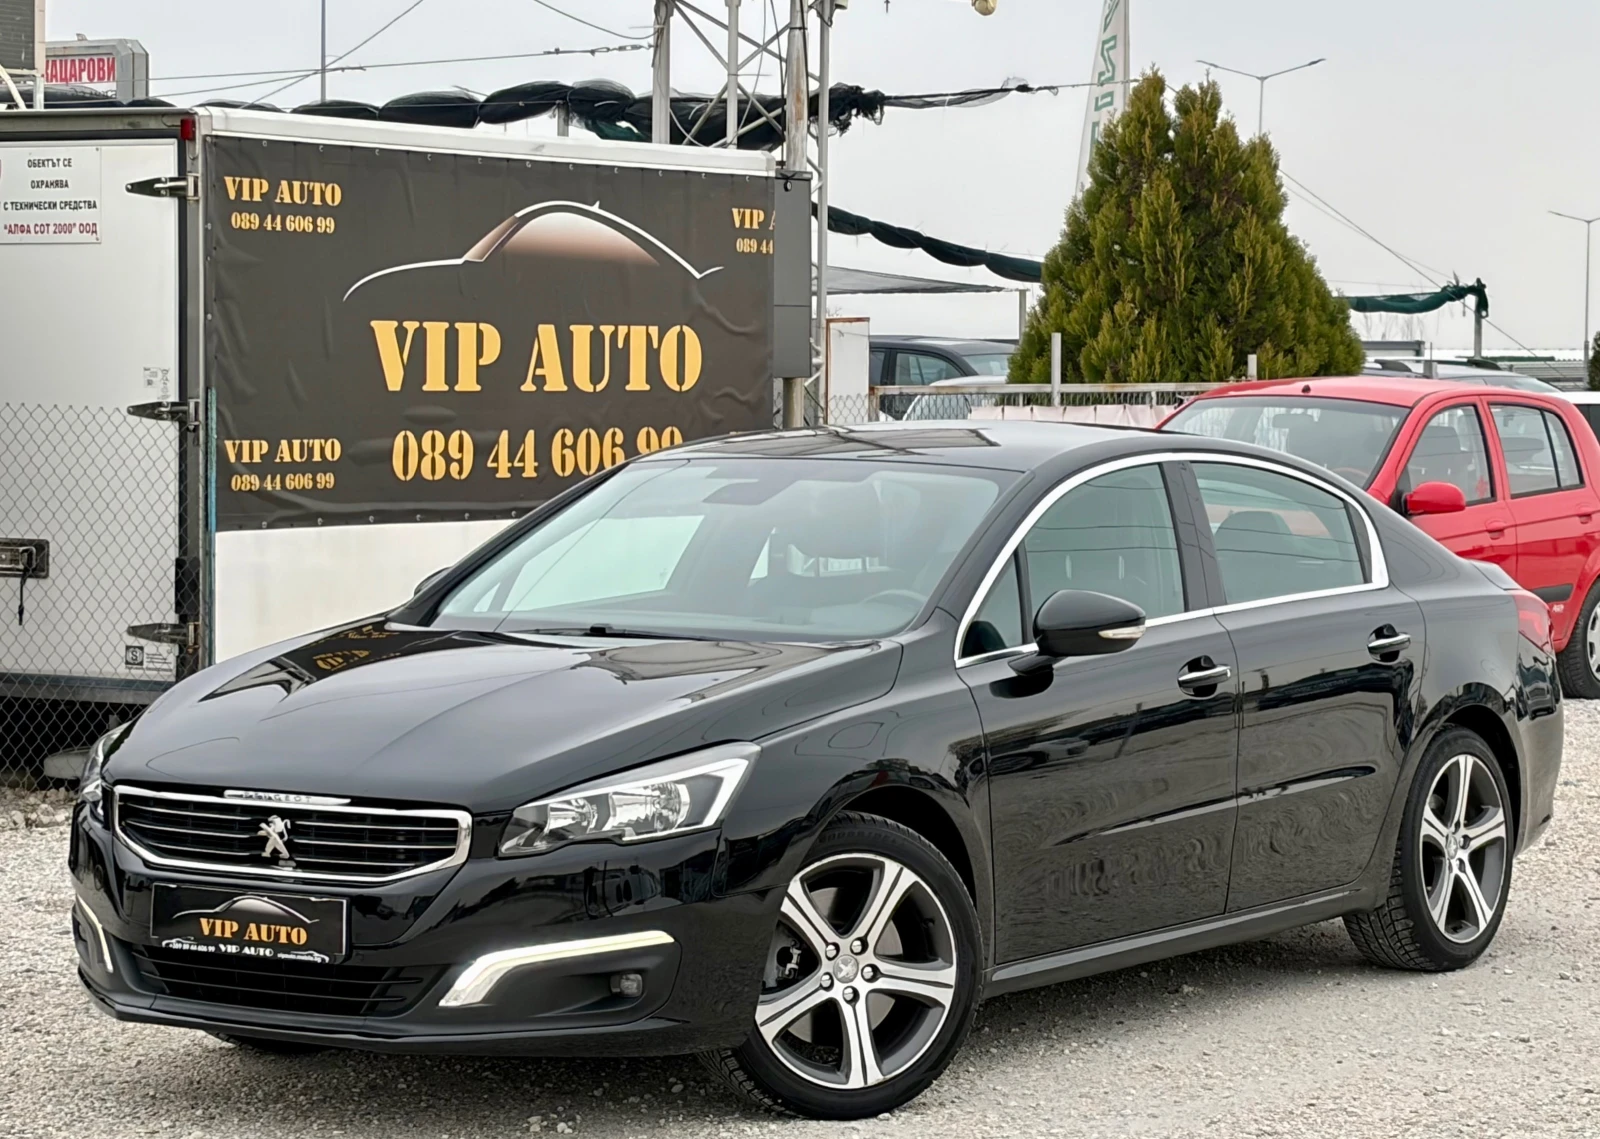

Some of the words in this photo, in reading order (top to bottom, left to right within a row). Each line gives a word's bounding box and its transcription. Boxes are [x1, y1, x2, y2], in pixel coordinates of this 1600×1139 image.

[27, 158, 61, 168] ОБЕКТЪТ
[62, 158, 72, 168] СЕ
[30, 179, 69, 189] ОХРАНЯВА
[224, 176, 269, 202] VIP
[274, 180, 342, 206] AUTO
[10, 201, 57, 211] ТЕХНИЧЕСКИ
[59, 200, 97, 211] СРЕДСТВА
[231, 212, 260, 230] 089
[263, 214, 282, 231] 44
[285, 215, 314, 233] 606
[316, 217, 335, 234] 99
[731, 207, 765, 230] VIP
[34, 223, 50, 234] СОТ
[79, 223, 97, 236] ООД
[736, 238, 758, 253] 089
[370, 320, 501, 392] VIP
[520, 324, 703, 392] AUTO
[224, 440, 269, 463] VIP
[274, 438, 341, 462] AUTO
[392, 429, 474, 481] 089
[486, 429, 539, 479] 44
[551, 427, 627, 477] 606
[231, 474, 260, 491] 089
[263, 474, 282, 491] 44
[285, 472, 314, 490] 606
[316, 472, 335, 489] 99
[200, 918, 239, 938] VIP
[243, 923, 308, 946] AUTO
[218, 943, 240, 954] VIP
[242, 945, 274, 957] AUTO
